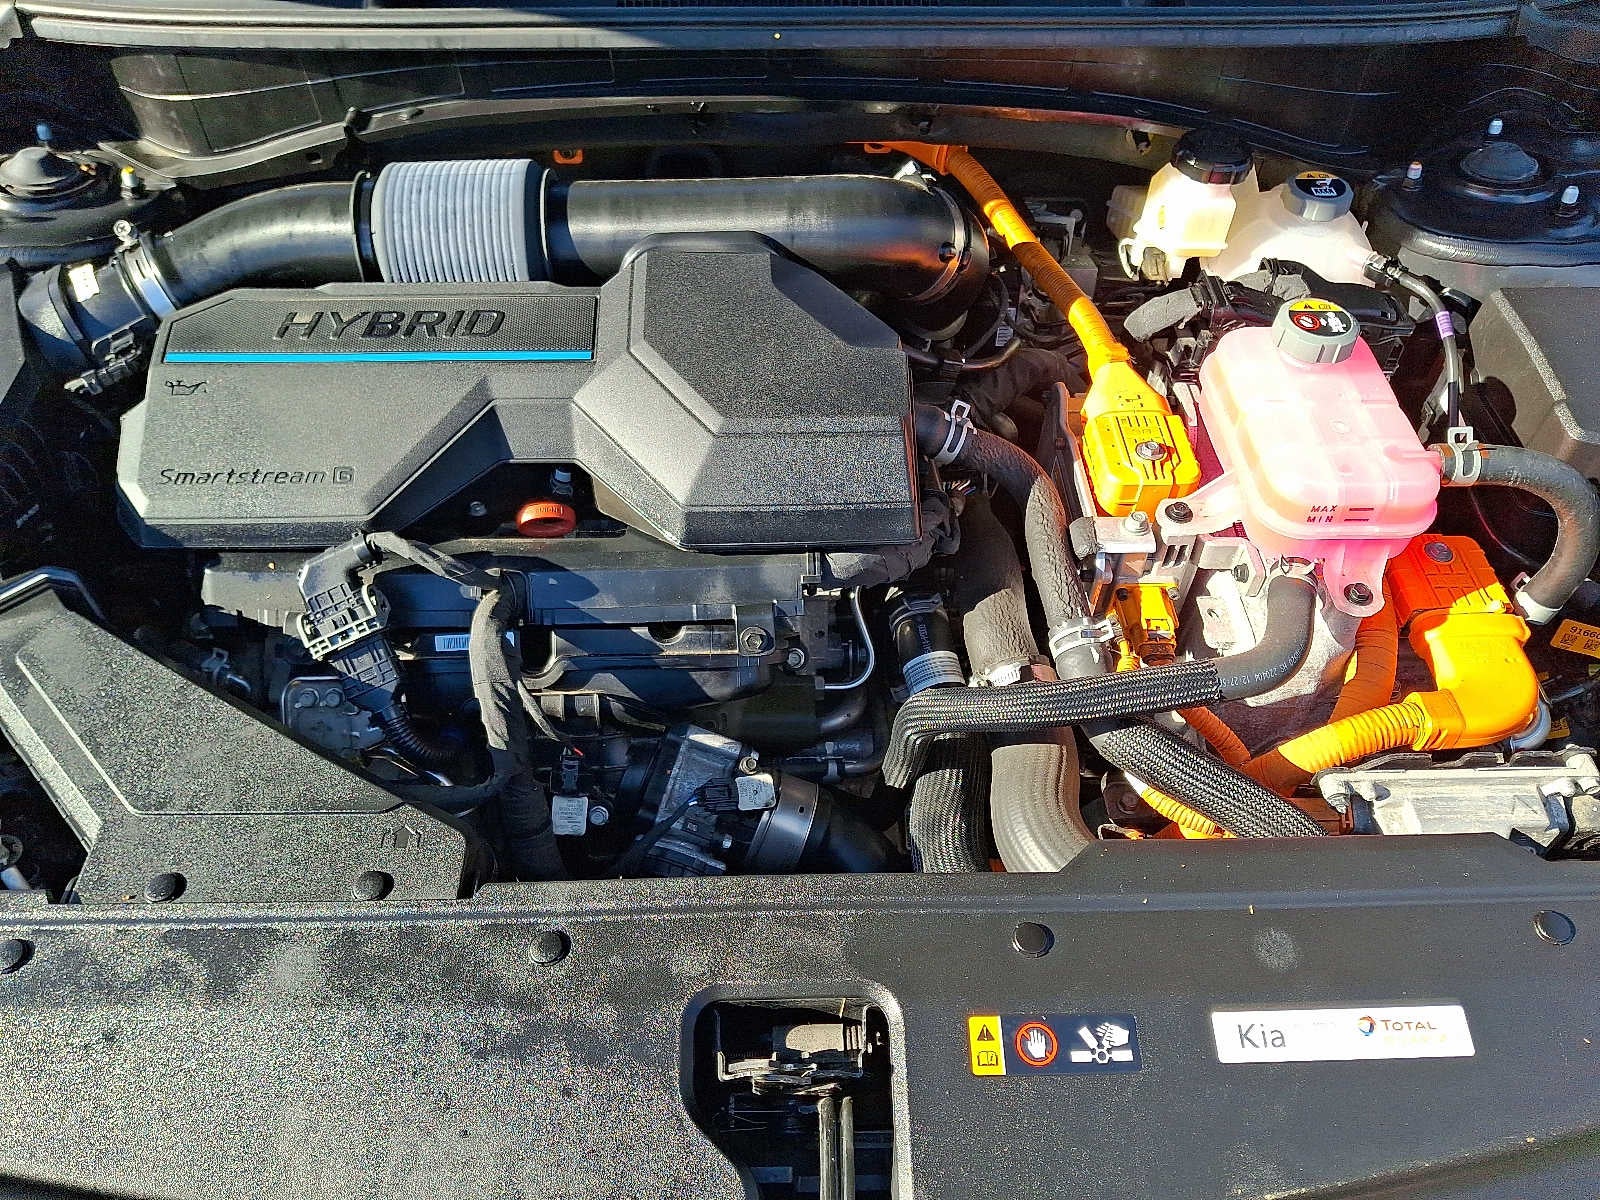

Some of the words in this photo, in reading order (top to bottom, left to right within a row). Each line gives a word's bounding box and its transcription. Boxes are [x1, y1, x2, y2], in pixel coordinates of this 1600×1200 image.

[273, 309, 506, 340] HYBRID
[157, 468, 327, 485] Smartstream
[1310, 504, 1338, 513] MAX
[1306, 515, 1334, 523] MIN
[1380, 1018, 1438, 1031] TOTAL
[1237, 1023, 1287, 1049] Kia
